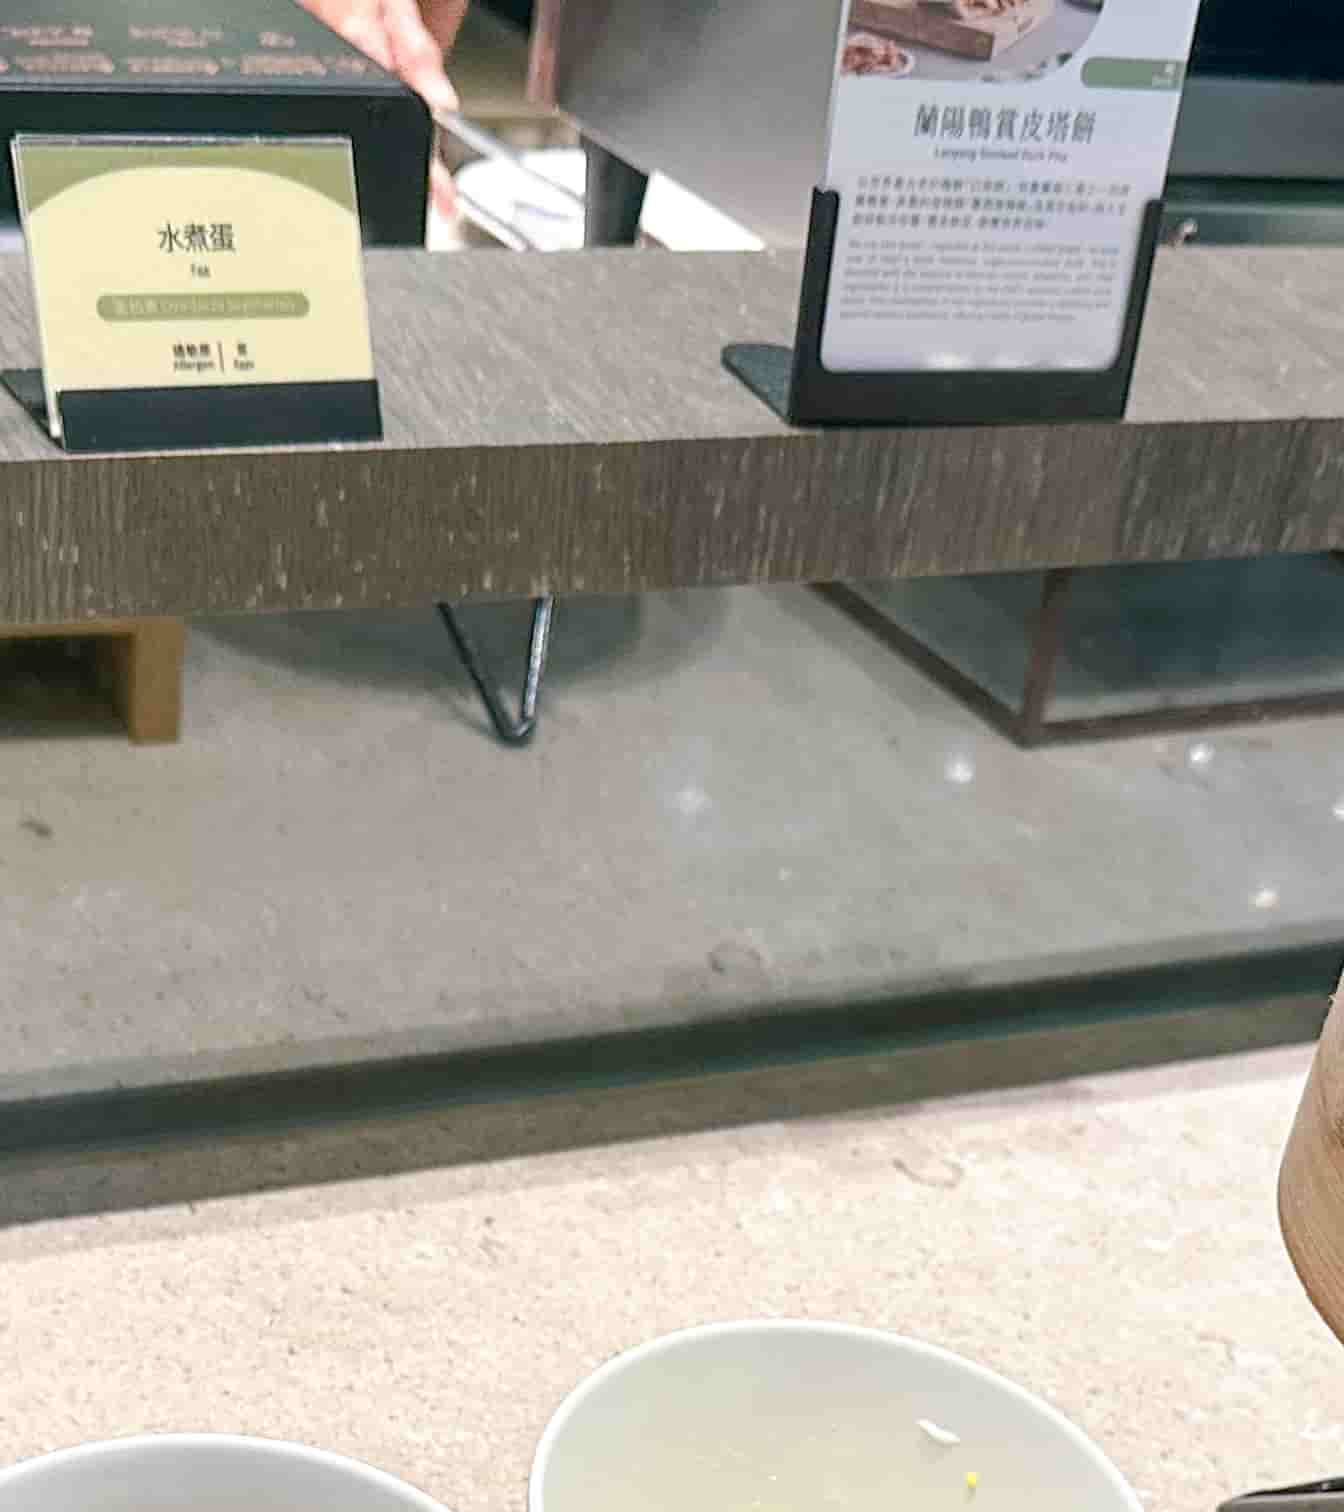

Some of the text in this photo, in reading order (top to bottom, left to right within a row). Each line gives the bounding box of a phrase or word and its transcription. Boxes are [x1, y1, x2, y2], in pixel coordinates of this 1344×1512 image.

[914, 104, 1096, 144] 蘭陽鴨賞皮塔餅
[158, 222, 236, 252] 水煮蛋
